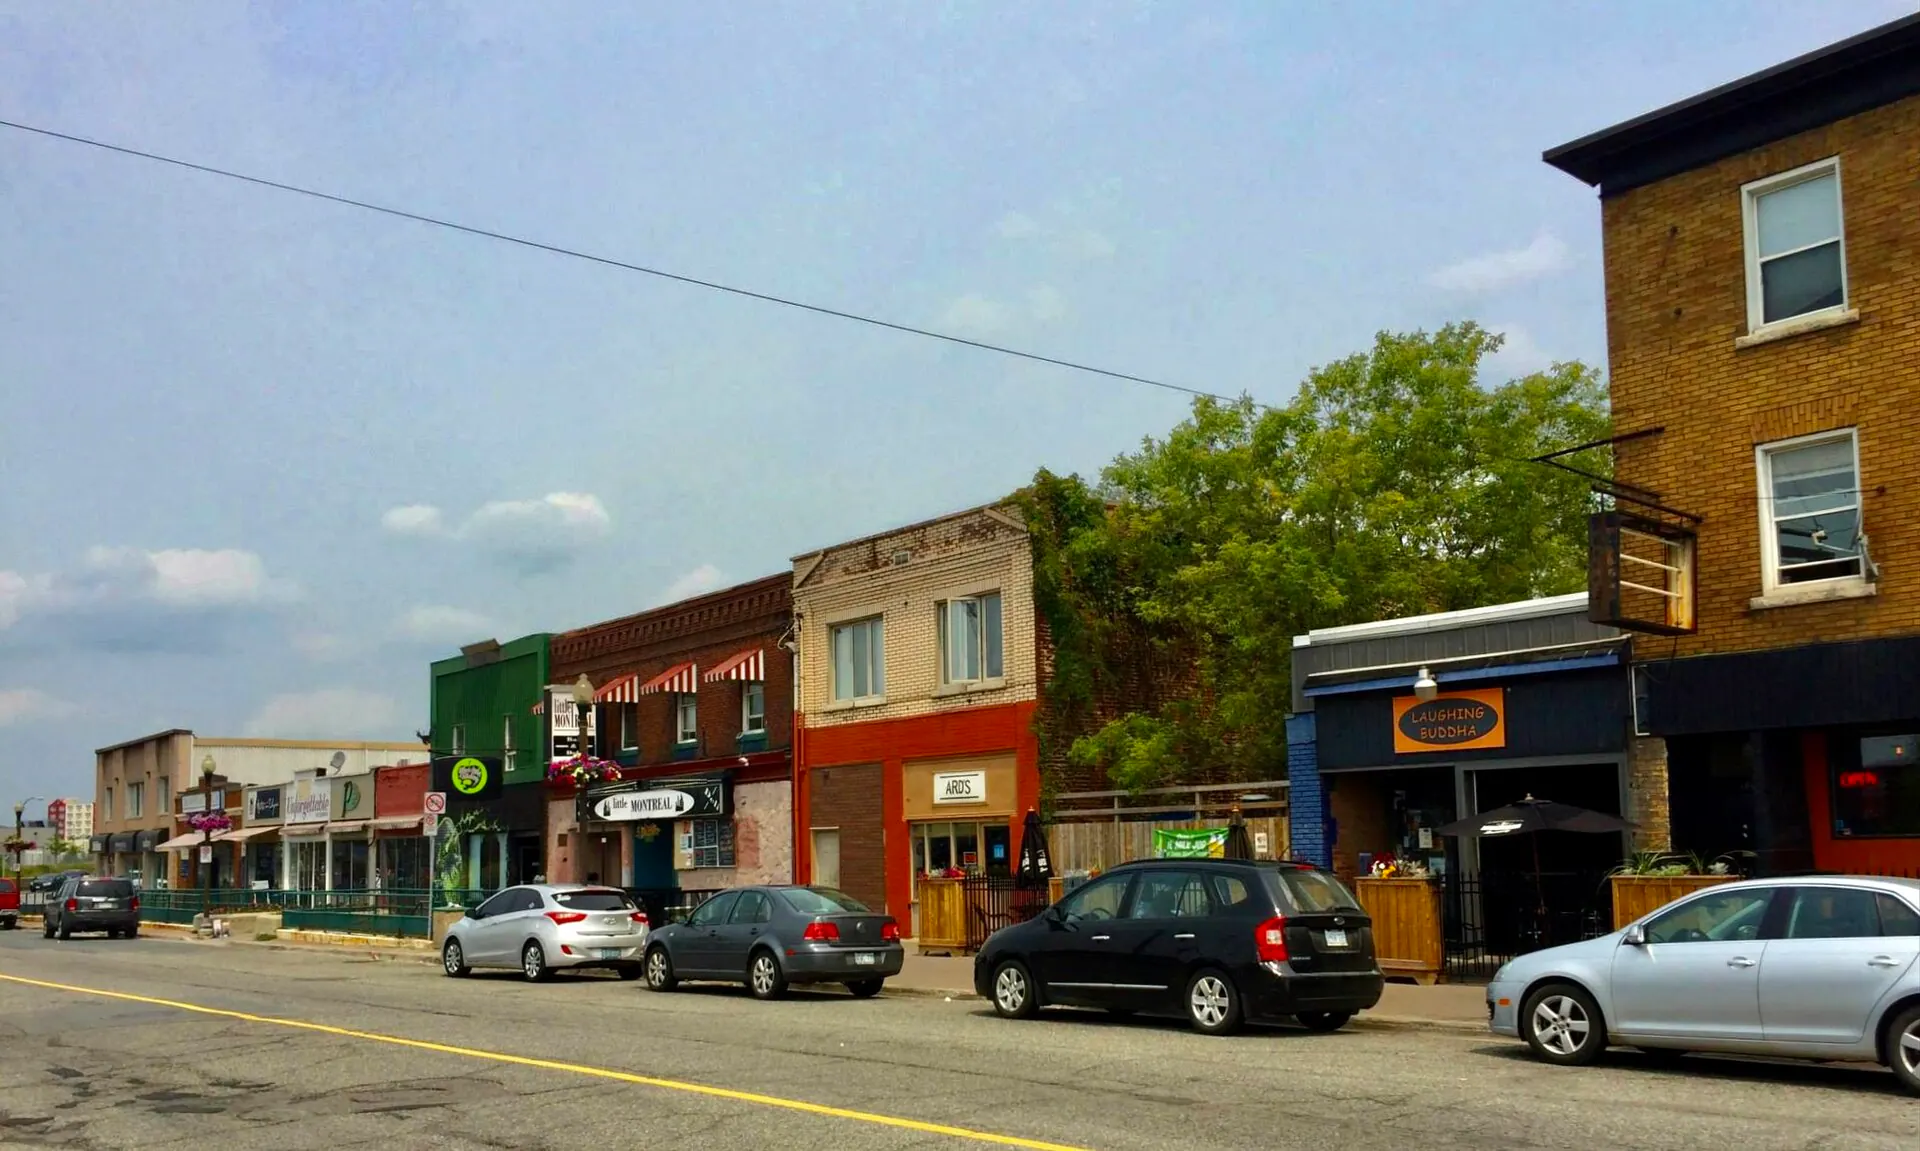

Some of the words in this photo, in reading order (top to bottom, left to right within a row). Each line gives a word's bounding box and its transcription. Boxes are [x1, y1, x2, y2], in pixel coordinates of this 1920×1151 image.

[554, 698, 571, 713] little
[1411, 706, 1485, 723] LAUGHING
[1420, 725, 1477, 740] BUDDHA
[946, 779, 971, 795] ARD'S
[1840, 771, 1877, 787] OPEN
[613, 796, 628, 809] little
[631, 797, 672, 812] MONTREAL
